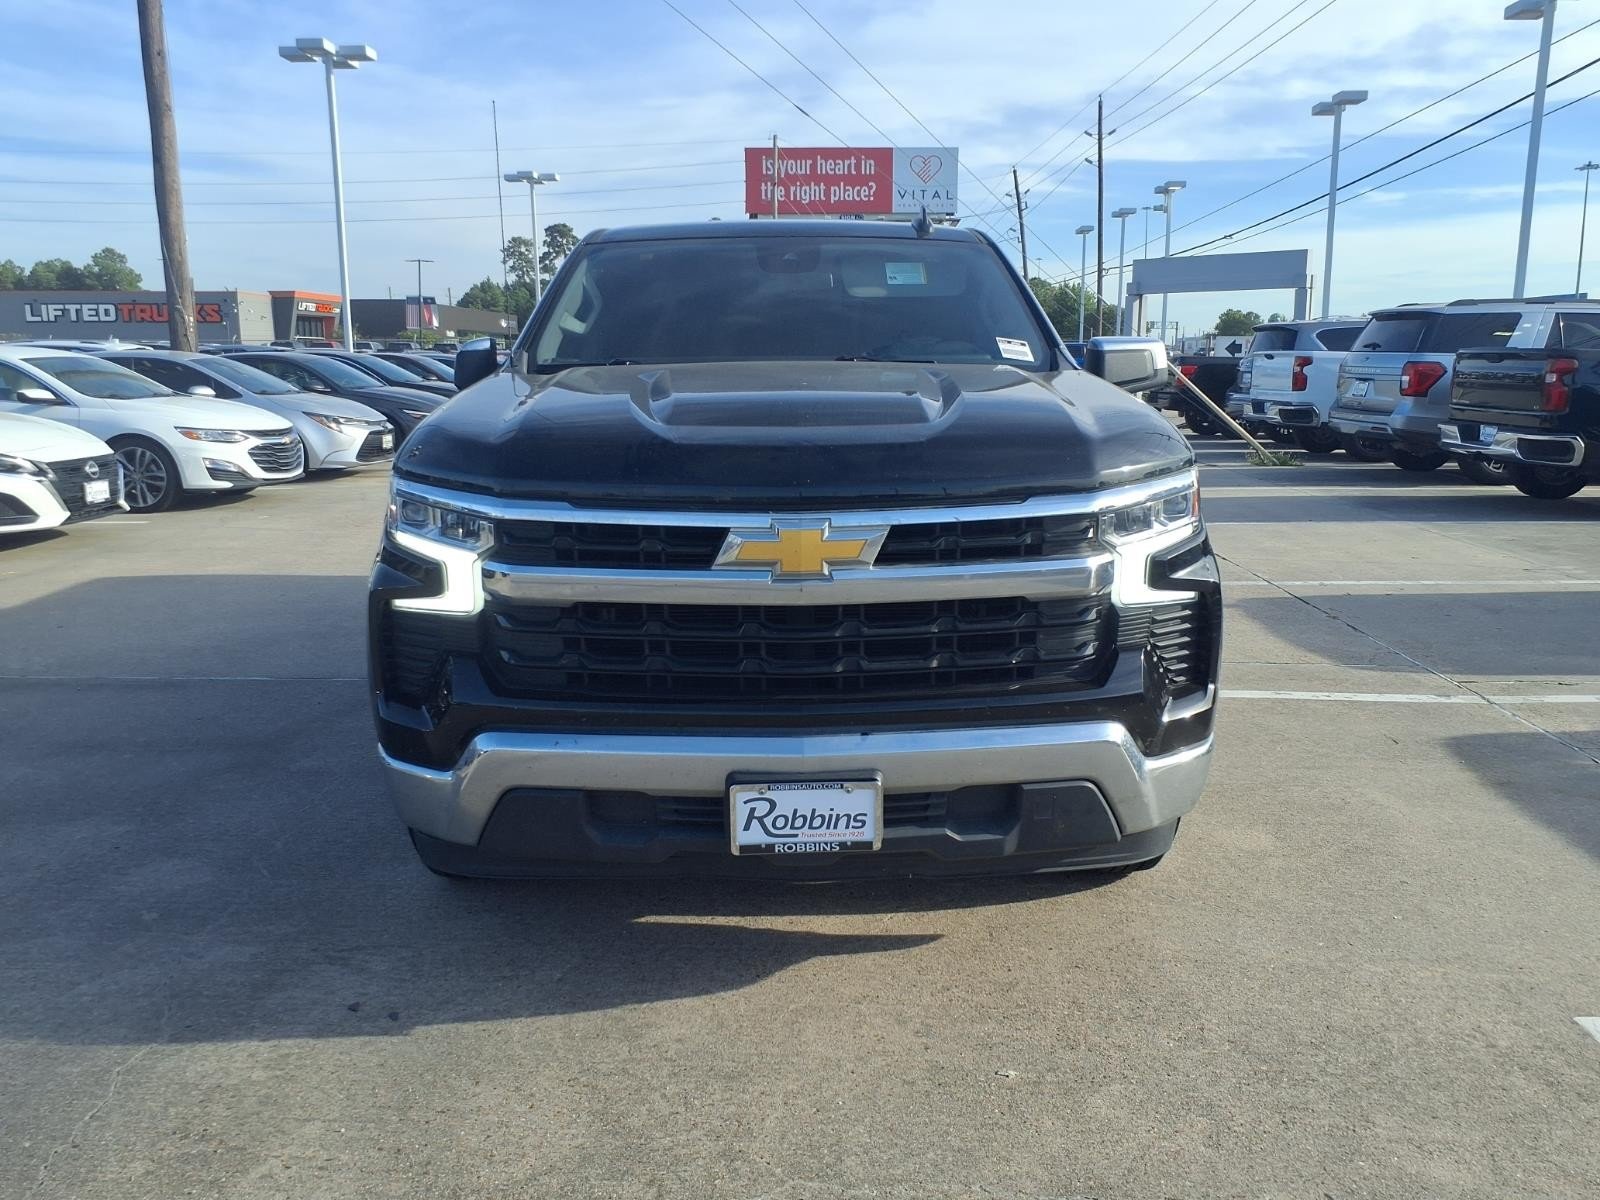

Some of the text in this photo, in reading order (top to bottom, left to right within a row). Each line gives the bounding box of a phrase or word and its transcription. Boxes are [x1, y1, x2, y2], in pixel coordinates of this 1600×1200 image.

[762, 155, 875, 178] is your heart in
[761, 181, 877, 204] the right place?
[897, 189, 954, 201] VITAL
[24, 303, 222, 323] LIFTED TRUKS
[742, 796, 868, 839] Robbins
[774, 842, 840, 853] ROBBINS
